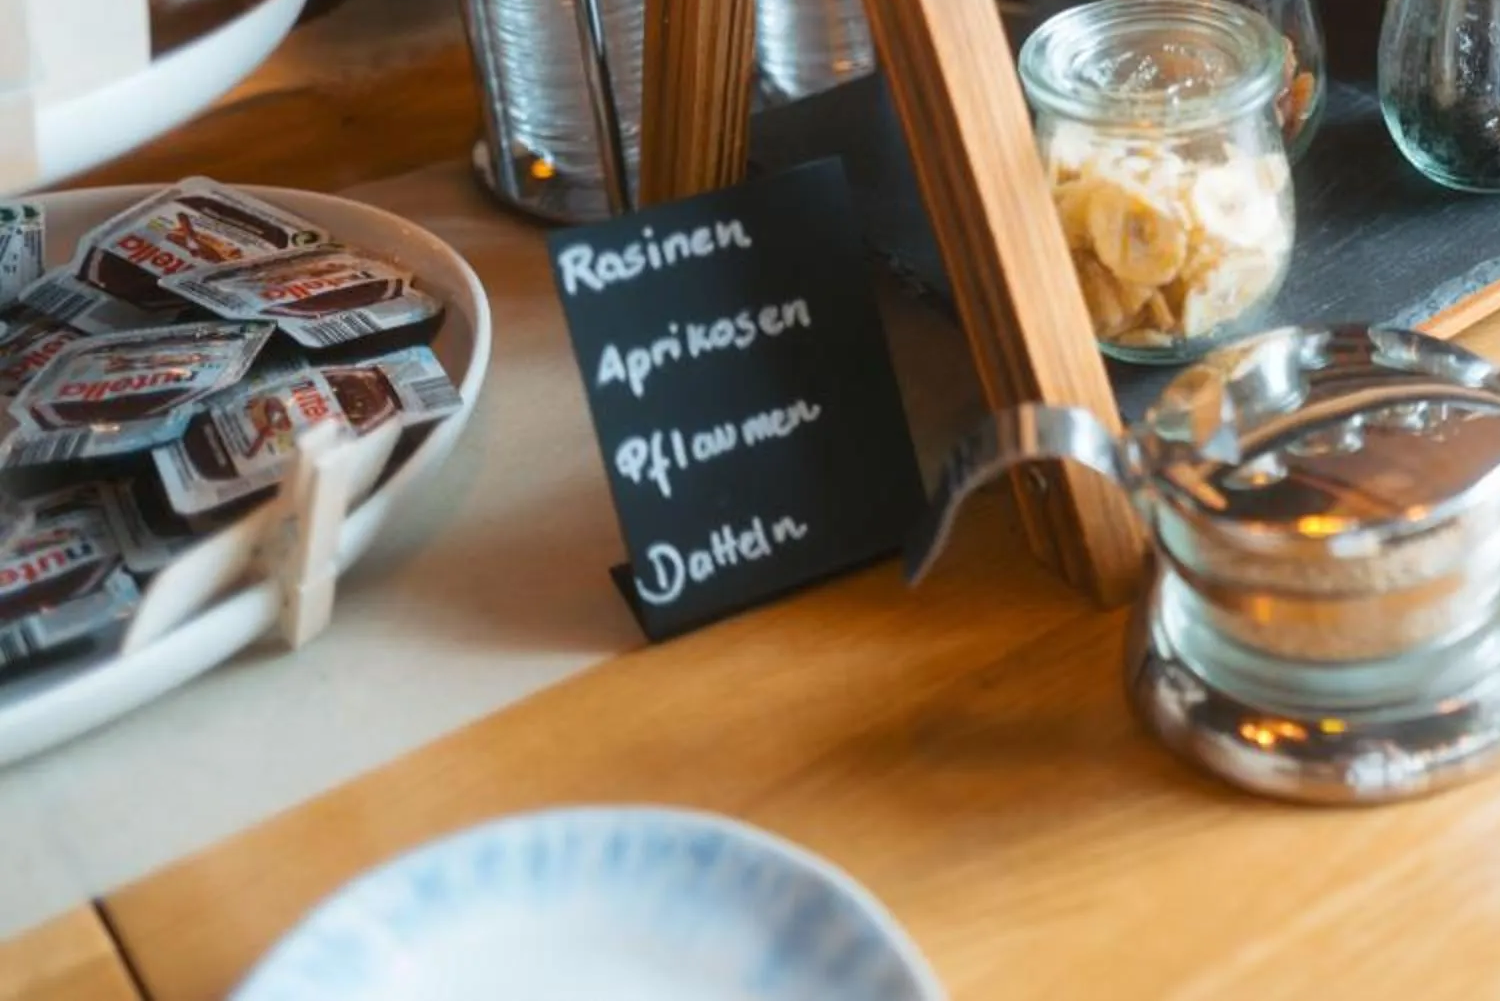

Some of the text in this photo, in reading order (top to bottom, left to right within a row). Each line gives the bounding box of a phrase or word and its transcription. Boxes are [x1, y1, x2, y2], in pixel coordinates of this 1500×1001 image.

[597, 298, 811, 398] Aprikosen
[615, 400, 821, 498] Pflaumen
[634, 516, 808, 605] Datteln
